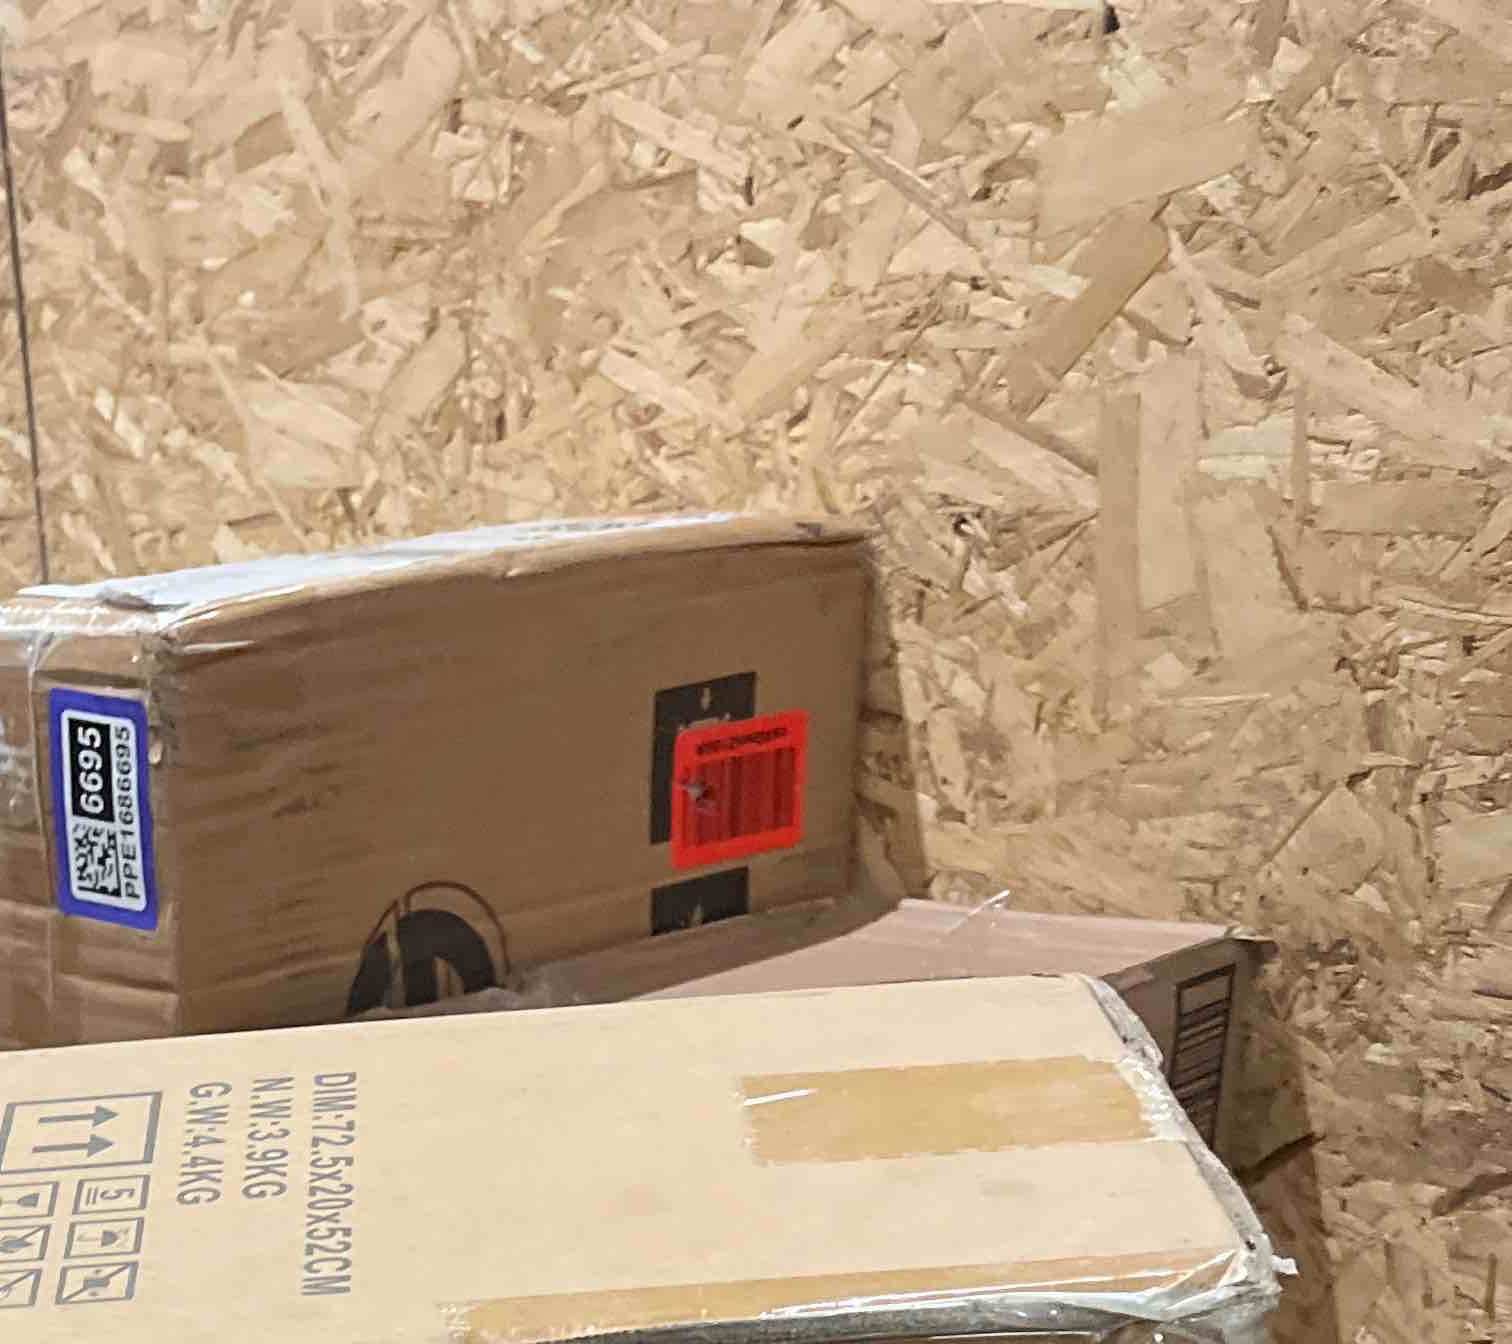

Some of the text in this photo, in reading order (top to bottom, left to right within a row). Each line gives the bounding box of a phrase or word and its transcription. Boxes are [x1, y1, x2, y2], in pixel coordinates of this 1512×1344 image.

[77, 726, 105, 814] 6695
[115, 726, 140, 899] PPE1686695
[175, 1081, 233, 1206] G.W:4.4KG
[242, 1076, 295, 1200] N.W:3.9KG
[301, 1071, 356, 1296] DIM:72.5x20x52CM
